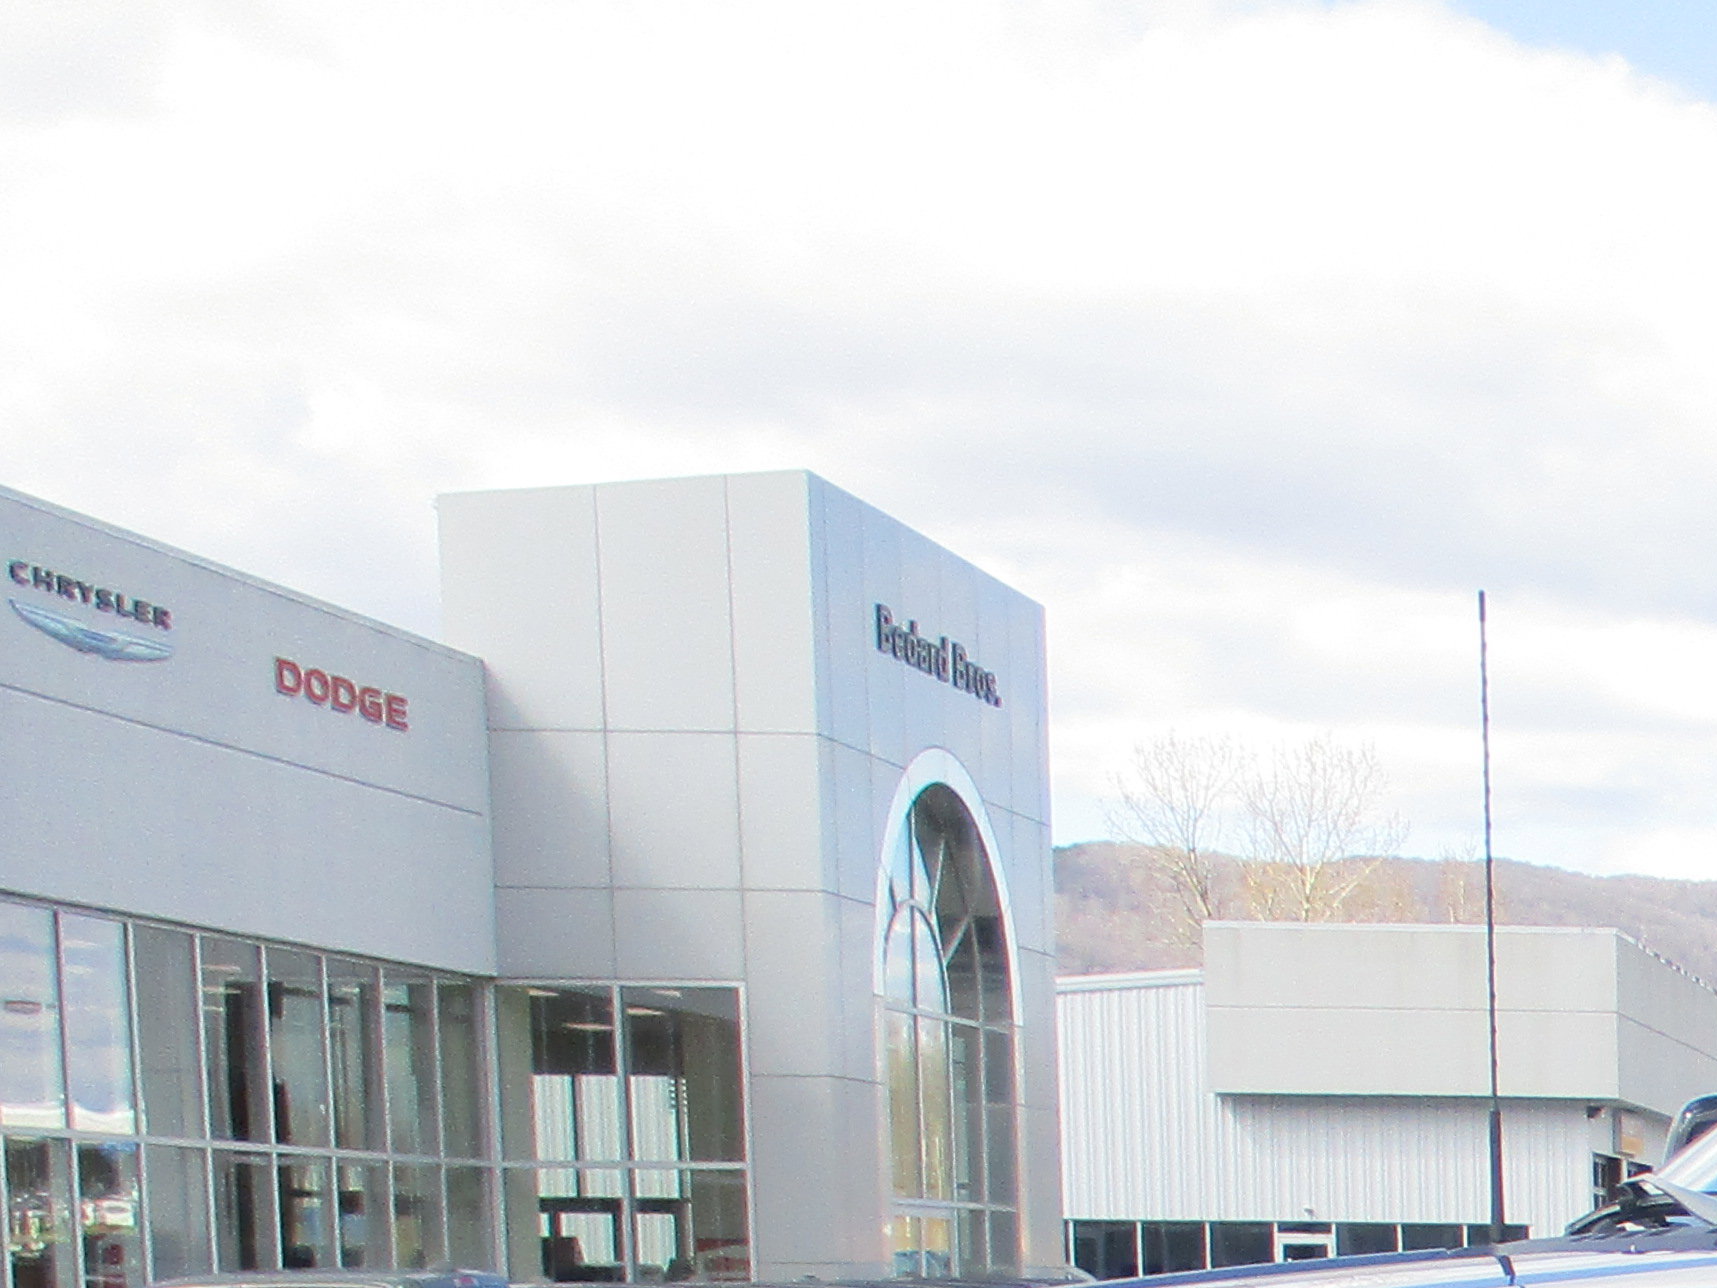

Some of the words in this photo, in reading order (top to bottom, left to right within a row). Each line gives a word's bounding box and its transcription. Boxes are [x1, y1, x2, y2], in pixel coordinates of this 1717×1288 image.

[10, 560, 173, 630] CHRYSLER
[876, 603, 950, 683] Bedard
[952, 641, 1002, 708] Bros.
[275, 657, 409, 732] DODGE
